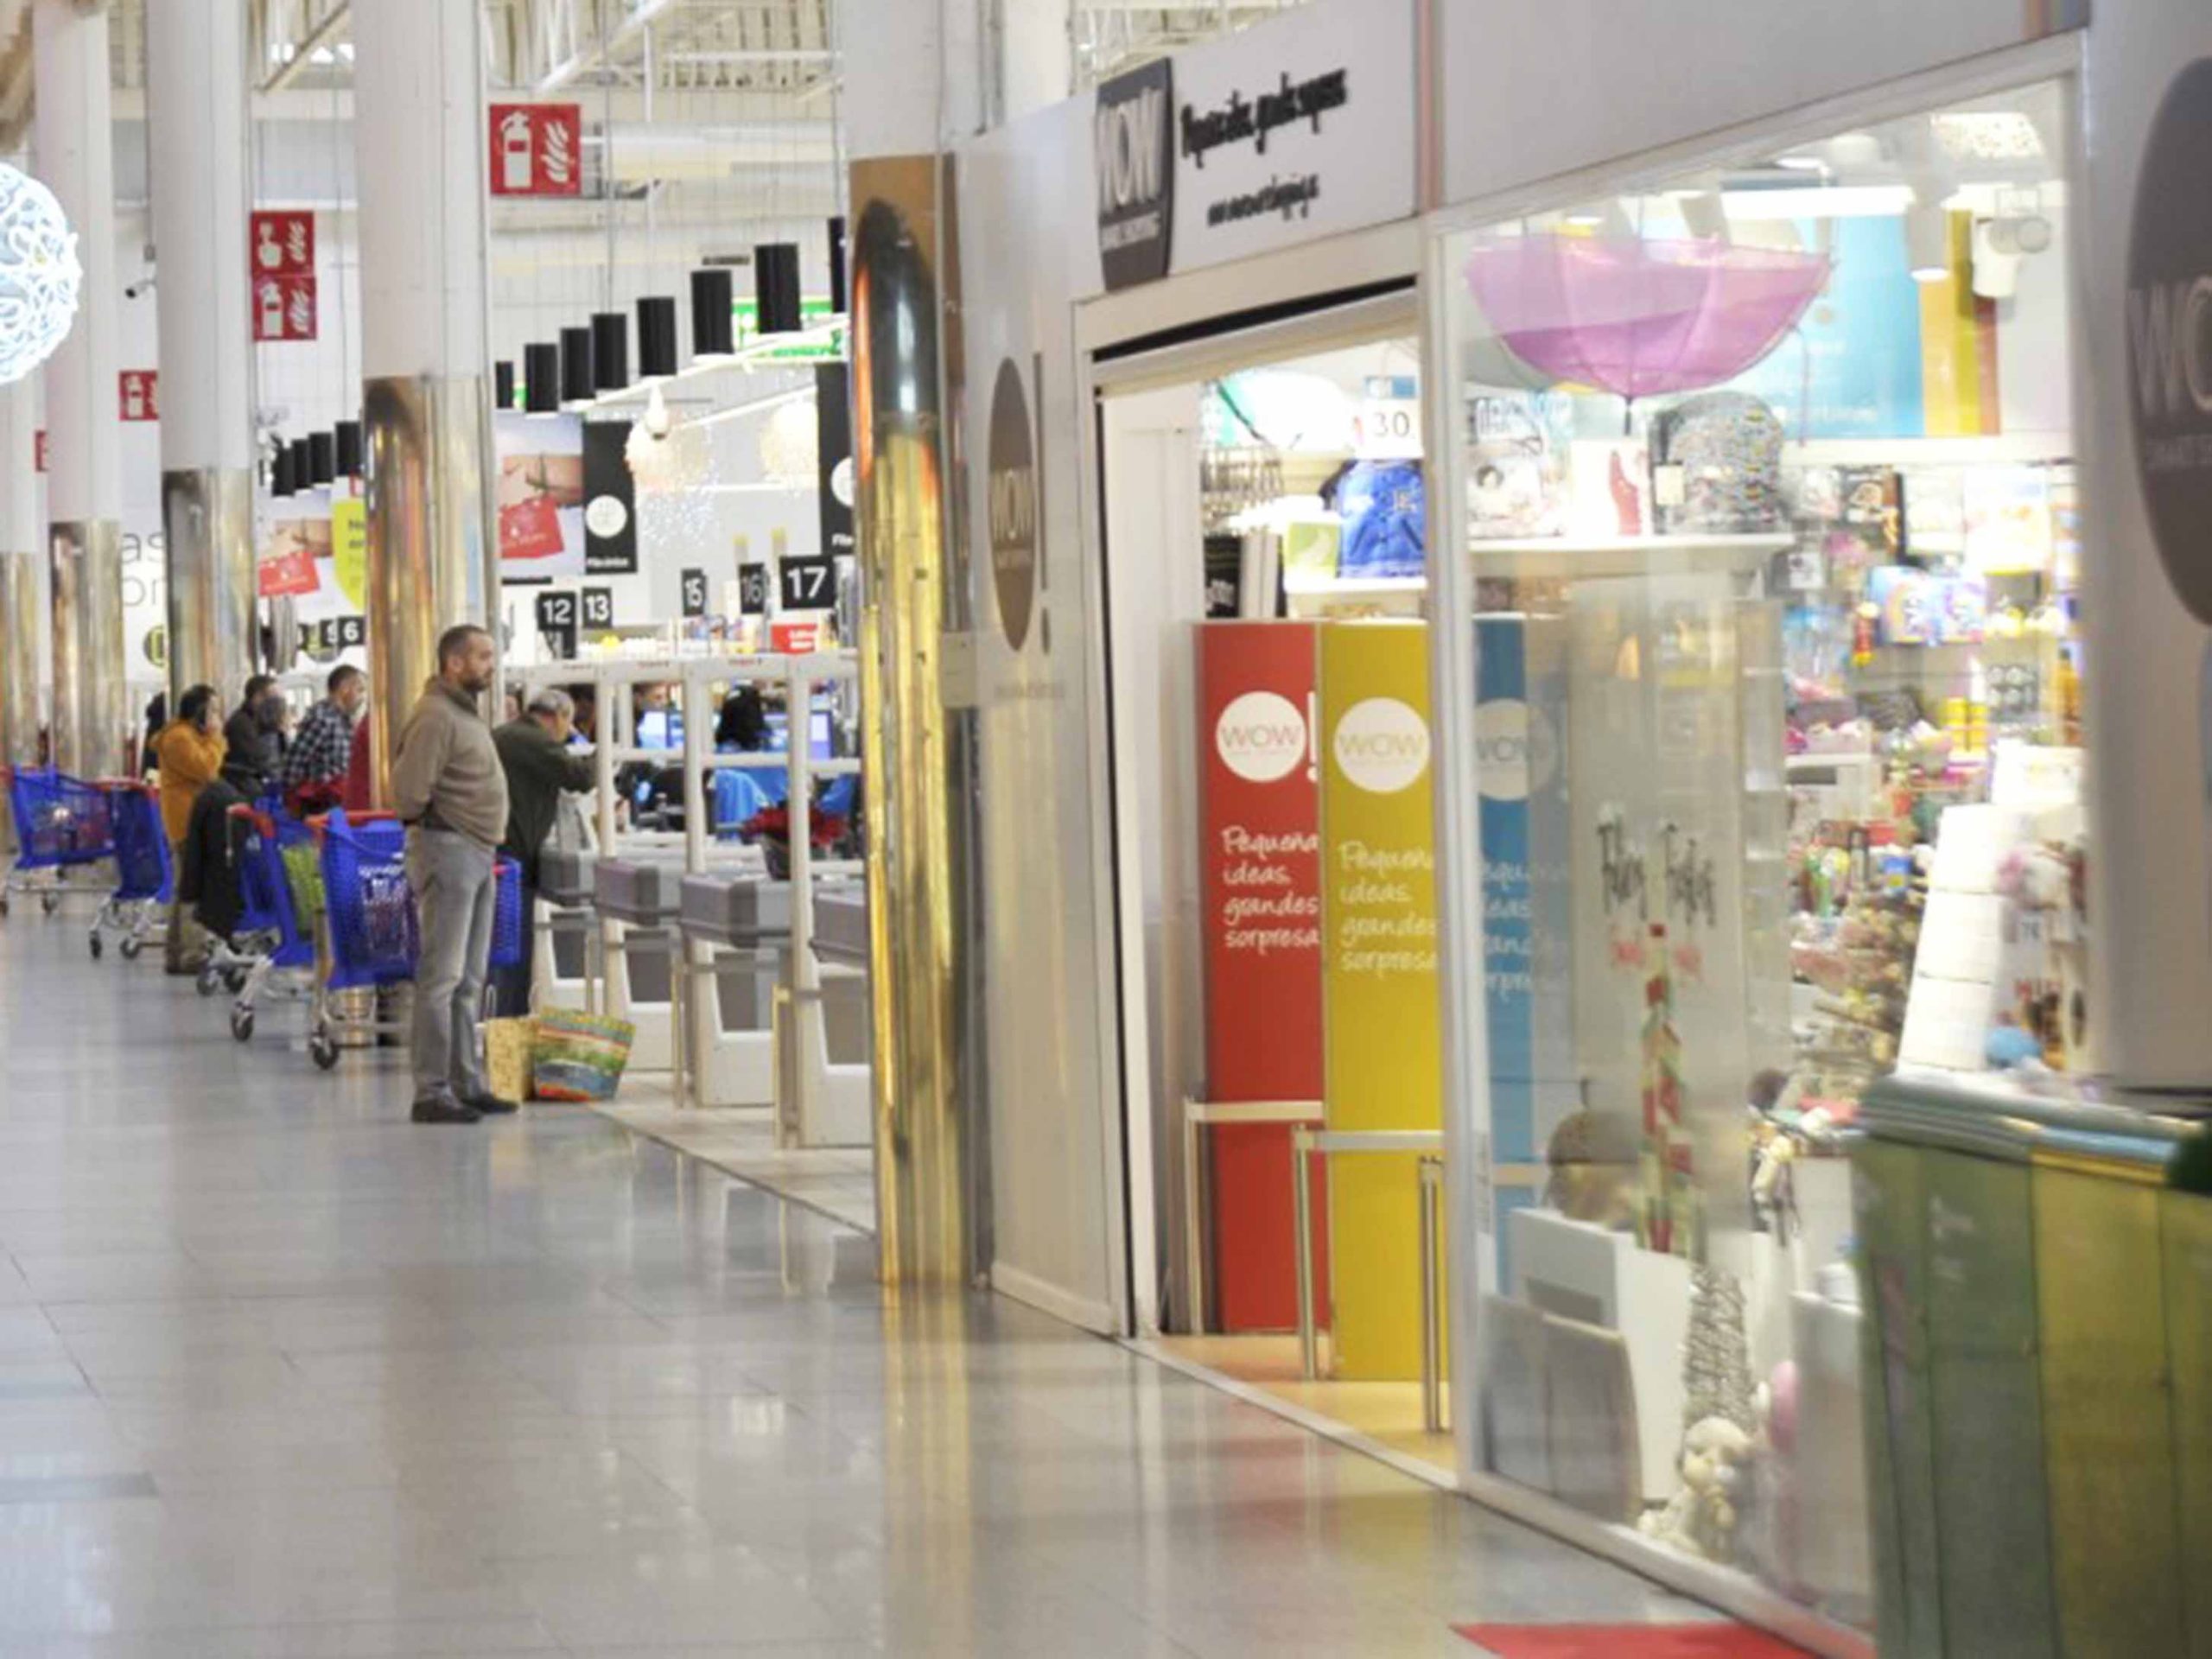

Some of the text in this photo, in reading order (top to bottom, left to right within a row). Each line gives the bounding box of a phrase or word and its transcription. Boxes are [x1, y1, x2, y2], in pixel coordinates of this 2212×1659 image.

[1372, 410, 1410, 436] 30
[787, 566, 827, 599] 17
[543, 598, 571, 625] 12
[586, 594, 609, 621] 13
[344, 620, 359, 643] 6
[1221, 724, 1303, 748] WOW
[1338, 733, 1427, 757] WOW
[1224, 890, 1319, 927] grandes
